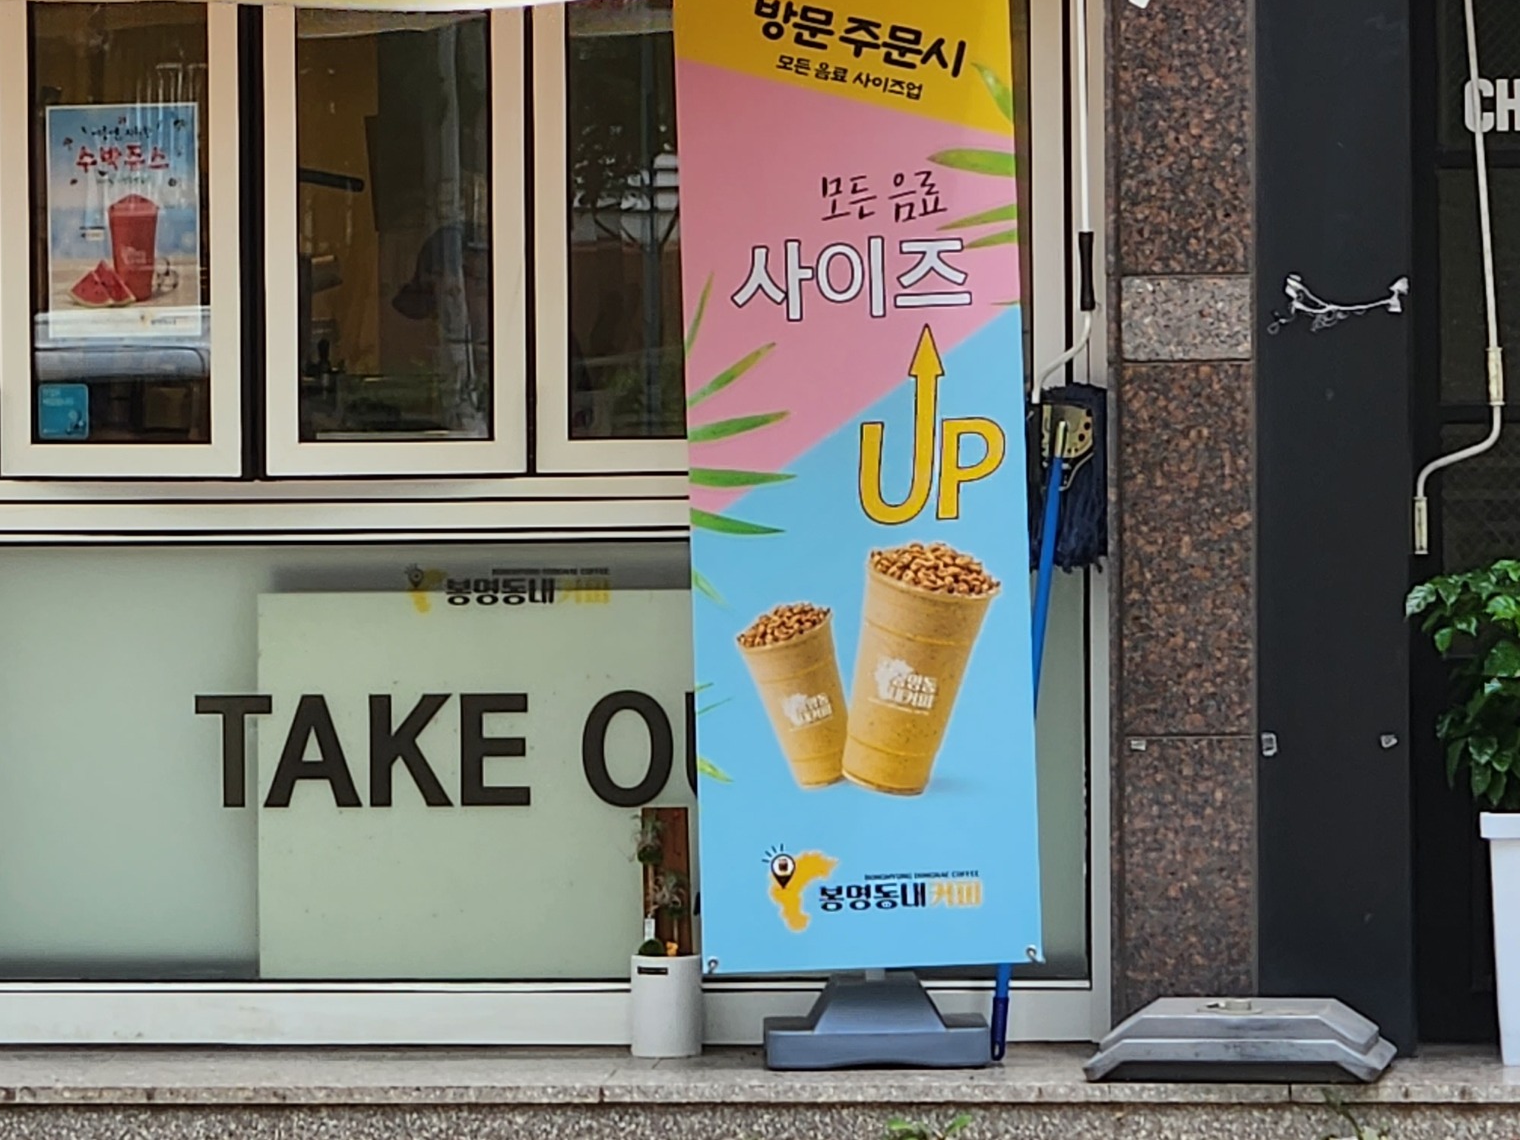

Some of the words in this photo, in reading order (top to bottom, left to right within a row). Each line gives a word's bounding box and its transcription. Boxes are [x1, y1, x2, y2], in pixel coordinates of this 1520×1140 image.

[775, 54, 811, 76] 모든
[814, 62, 849, 83] 음료
[852, 71, 923, 100] 사이즈업
[820, 173, 878, 223] 모든
[888, 169, 948, 223] 음료
[730, 235, 973, 322] 사이즈
[859, 375, 1006, 525] UP
[194, 691, 532, 809] TAKE
[582, 689, 697, 809] O
